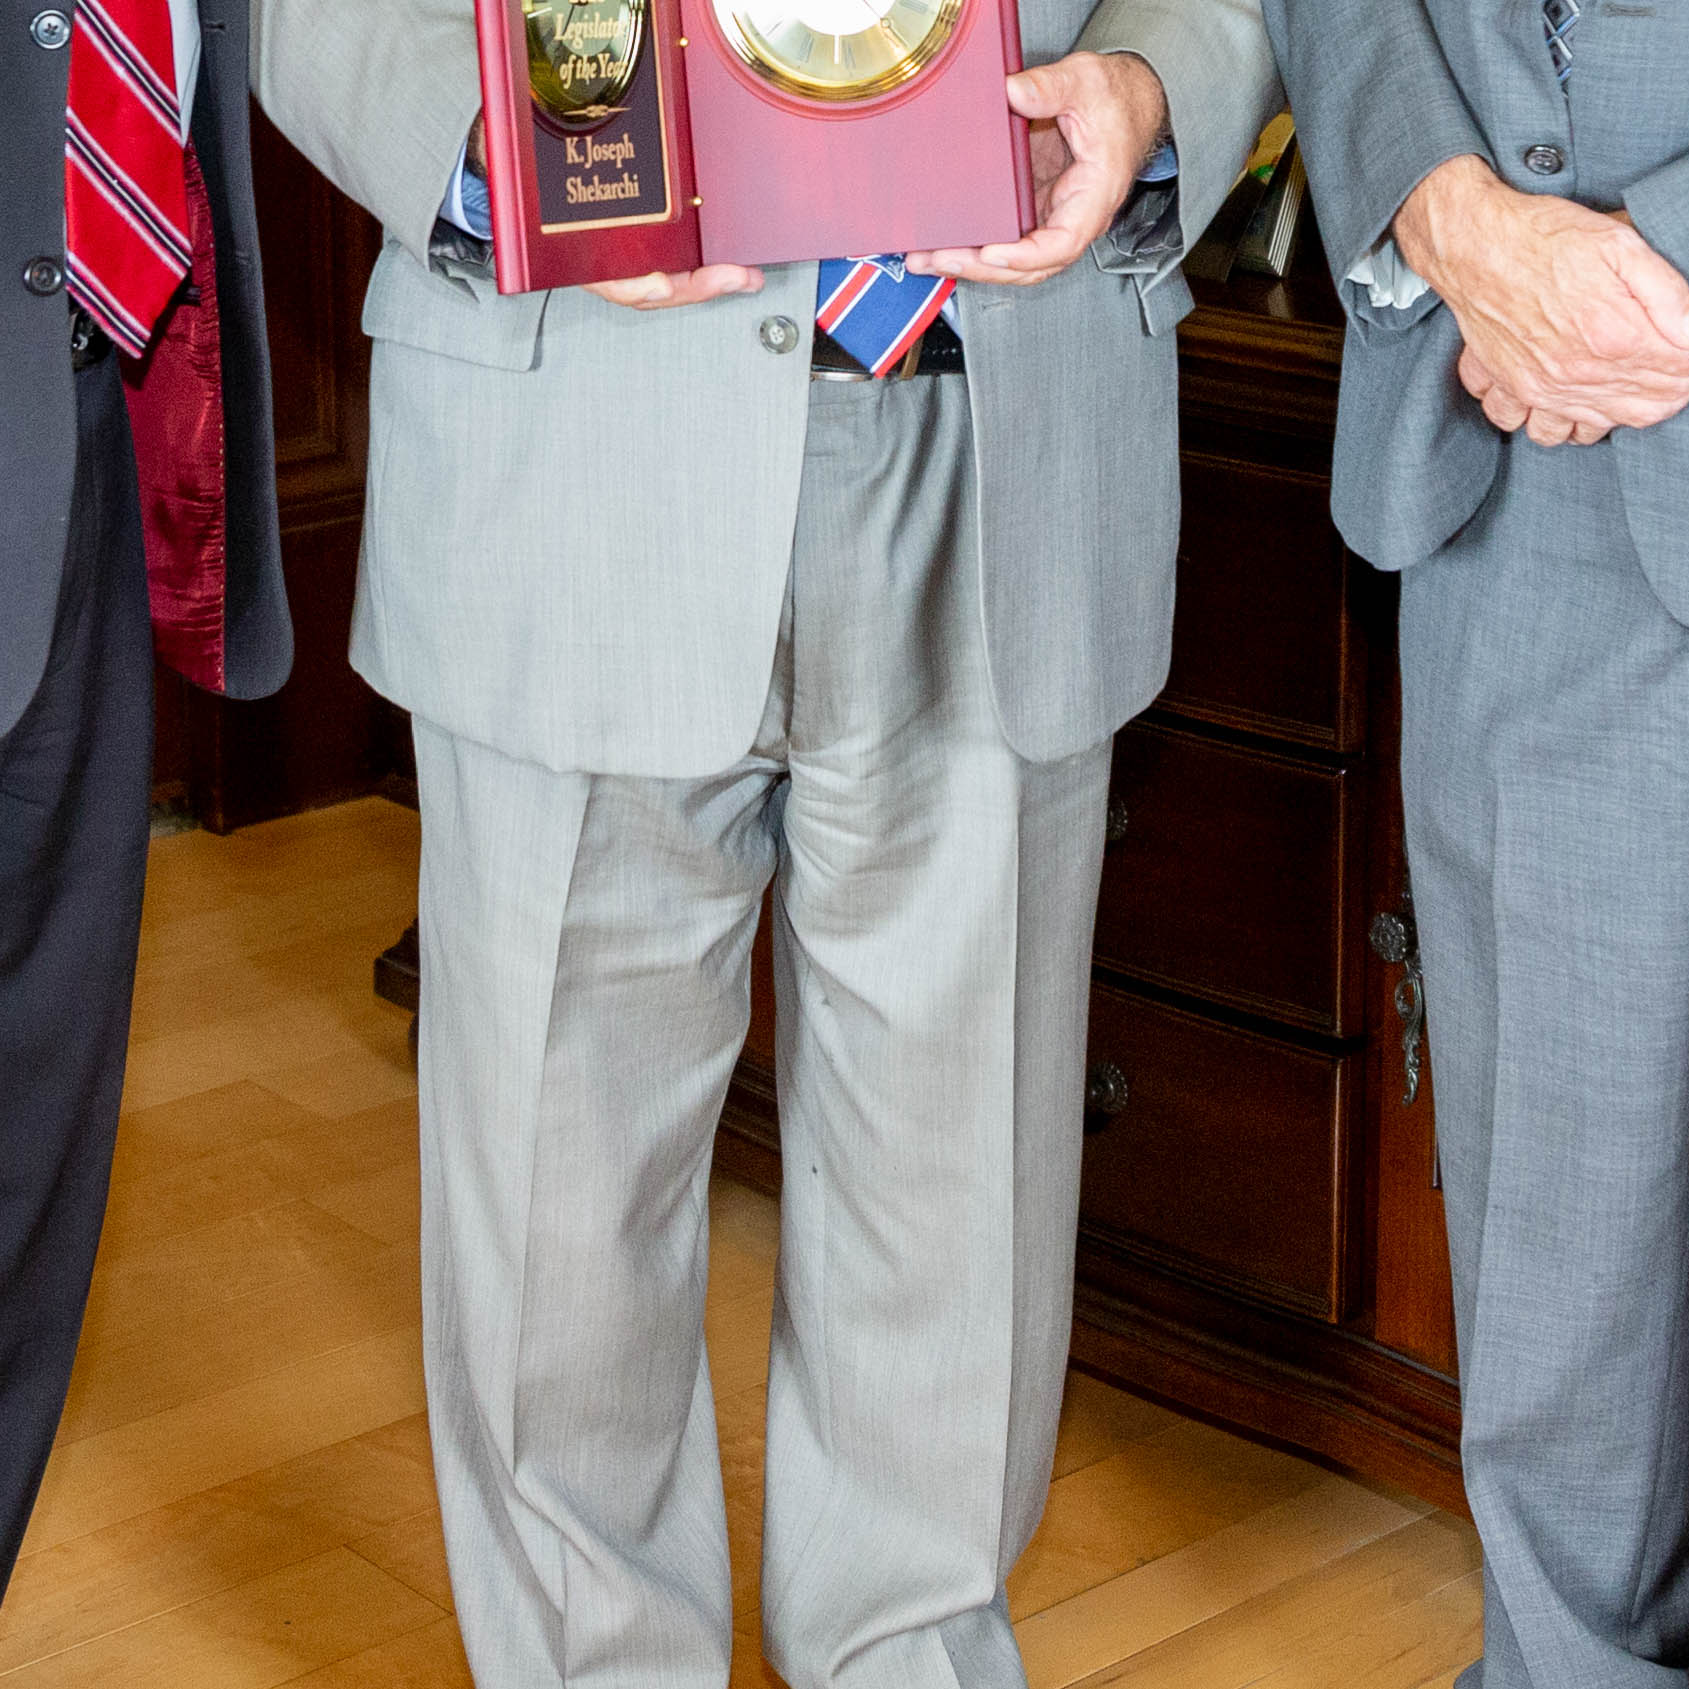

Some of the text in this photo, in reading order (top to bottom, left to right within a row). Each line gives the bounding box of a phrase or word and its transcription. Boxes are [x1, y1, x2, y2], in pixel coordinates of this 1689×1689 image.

[559, 54, 576, 89] of
[576, 54, 597, 81] the
[565, 133, 636, 169] K. Joseph
[565, 173, 641, 204] Shekarchi
